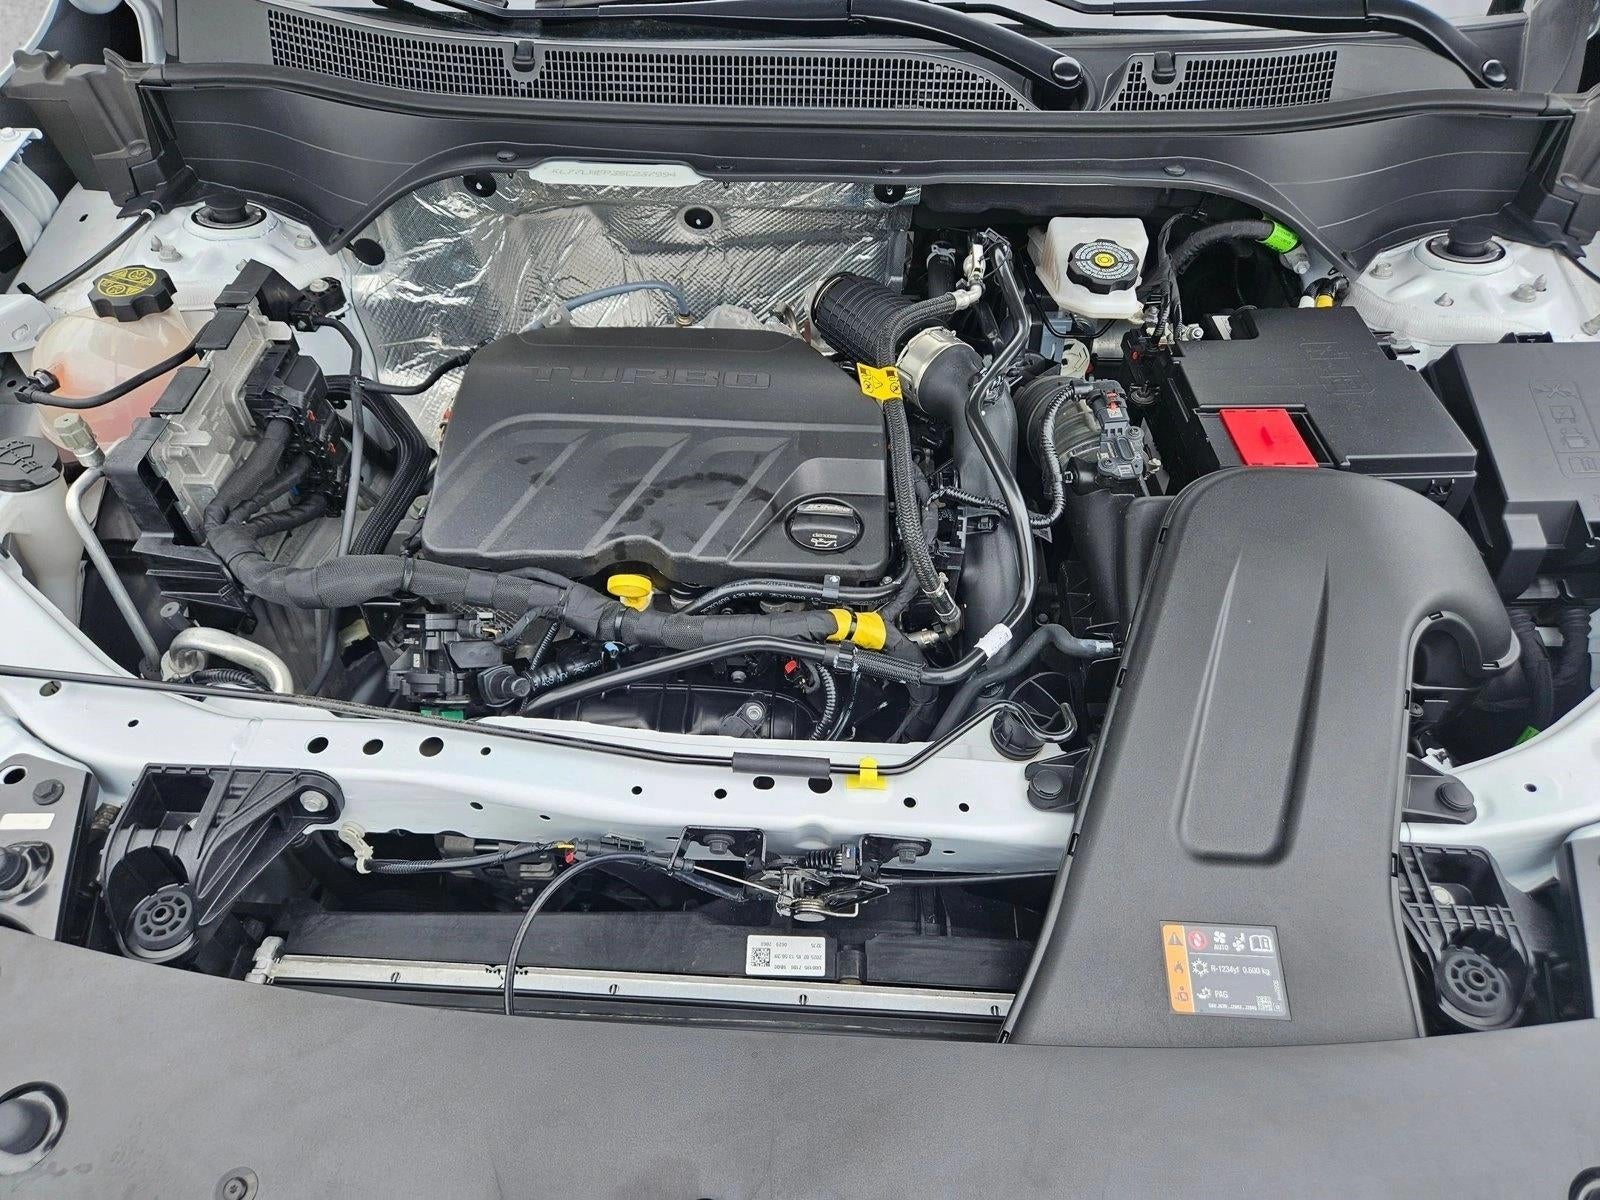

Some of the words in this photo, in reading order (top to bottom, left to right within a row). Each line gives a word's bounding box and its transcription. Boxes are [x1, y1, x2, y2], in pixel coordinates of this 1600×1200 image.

[525, 366, 771, 390] TURBO
[1210, 964, 1240, 974] R-1234yf
[1262, 967, 1271, 976] kg
[1214, 990, 1228, 998] PAG
